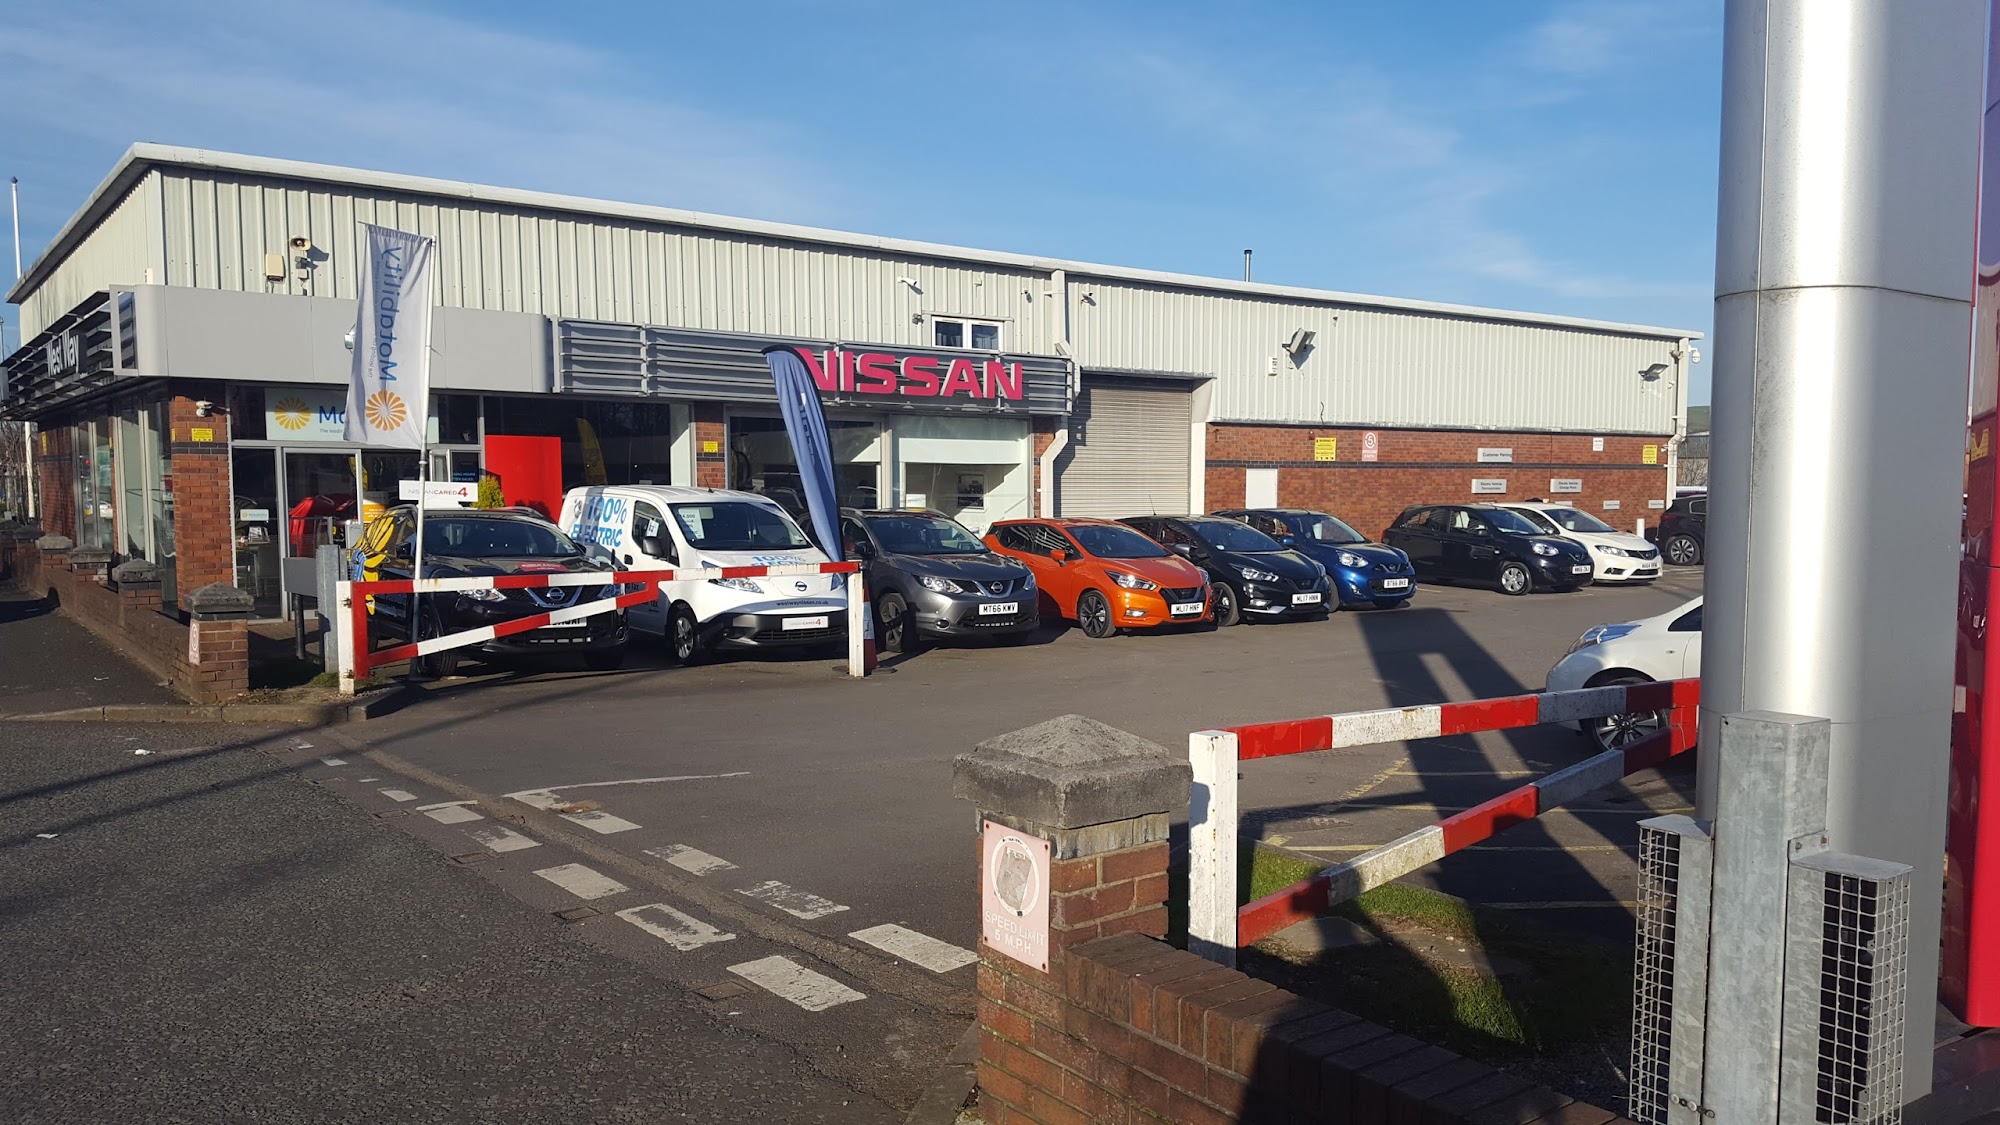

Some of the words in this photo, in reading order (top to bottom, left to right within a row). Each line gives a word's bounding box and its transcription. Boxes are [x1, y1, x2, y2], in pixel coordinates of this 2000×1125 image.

[46, 338, 63, 377] West
[62, 330, 79, 374] Way
[794, 347, 1023, 400] NISSAN
[587, 496, 627, 524] 100%
[571, 524, 622, 547] ELECTRIC
[983, 605, 1002, 613] MT66
[1002, 603, 1016, 612] KWV
[1175, 604, 1189, 612] ML17
[1189, 603, 1200, 611] HNF
[985, 910, 1017, 933] SPEED
[1019, 927, 1045, 946] LIMIT
[994, 929, 1001, 941] 5
[1005, 934, 1034, 956] M.P.H.
